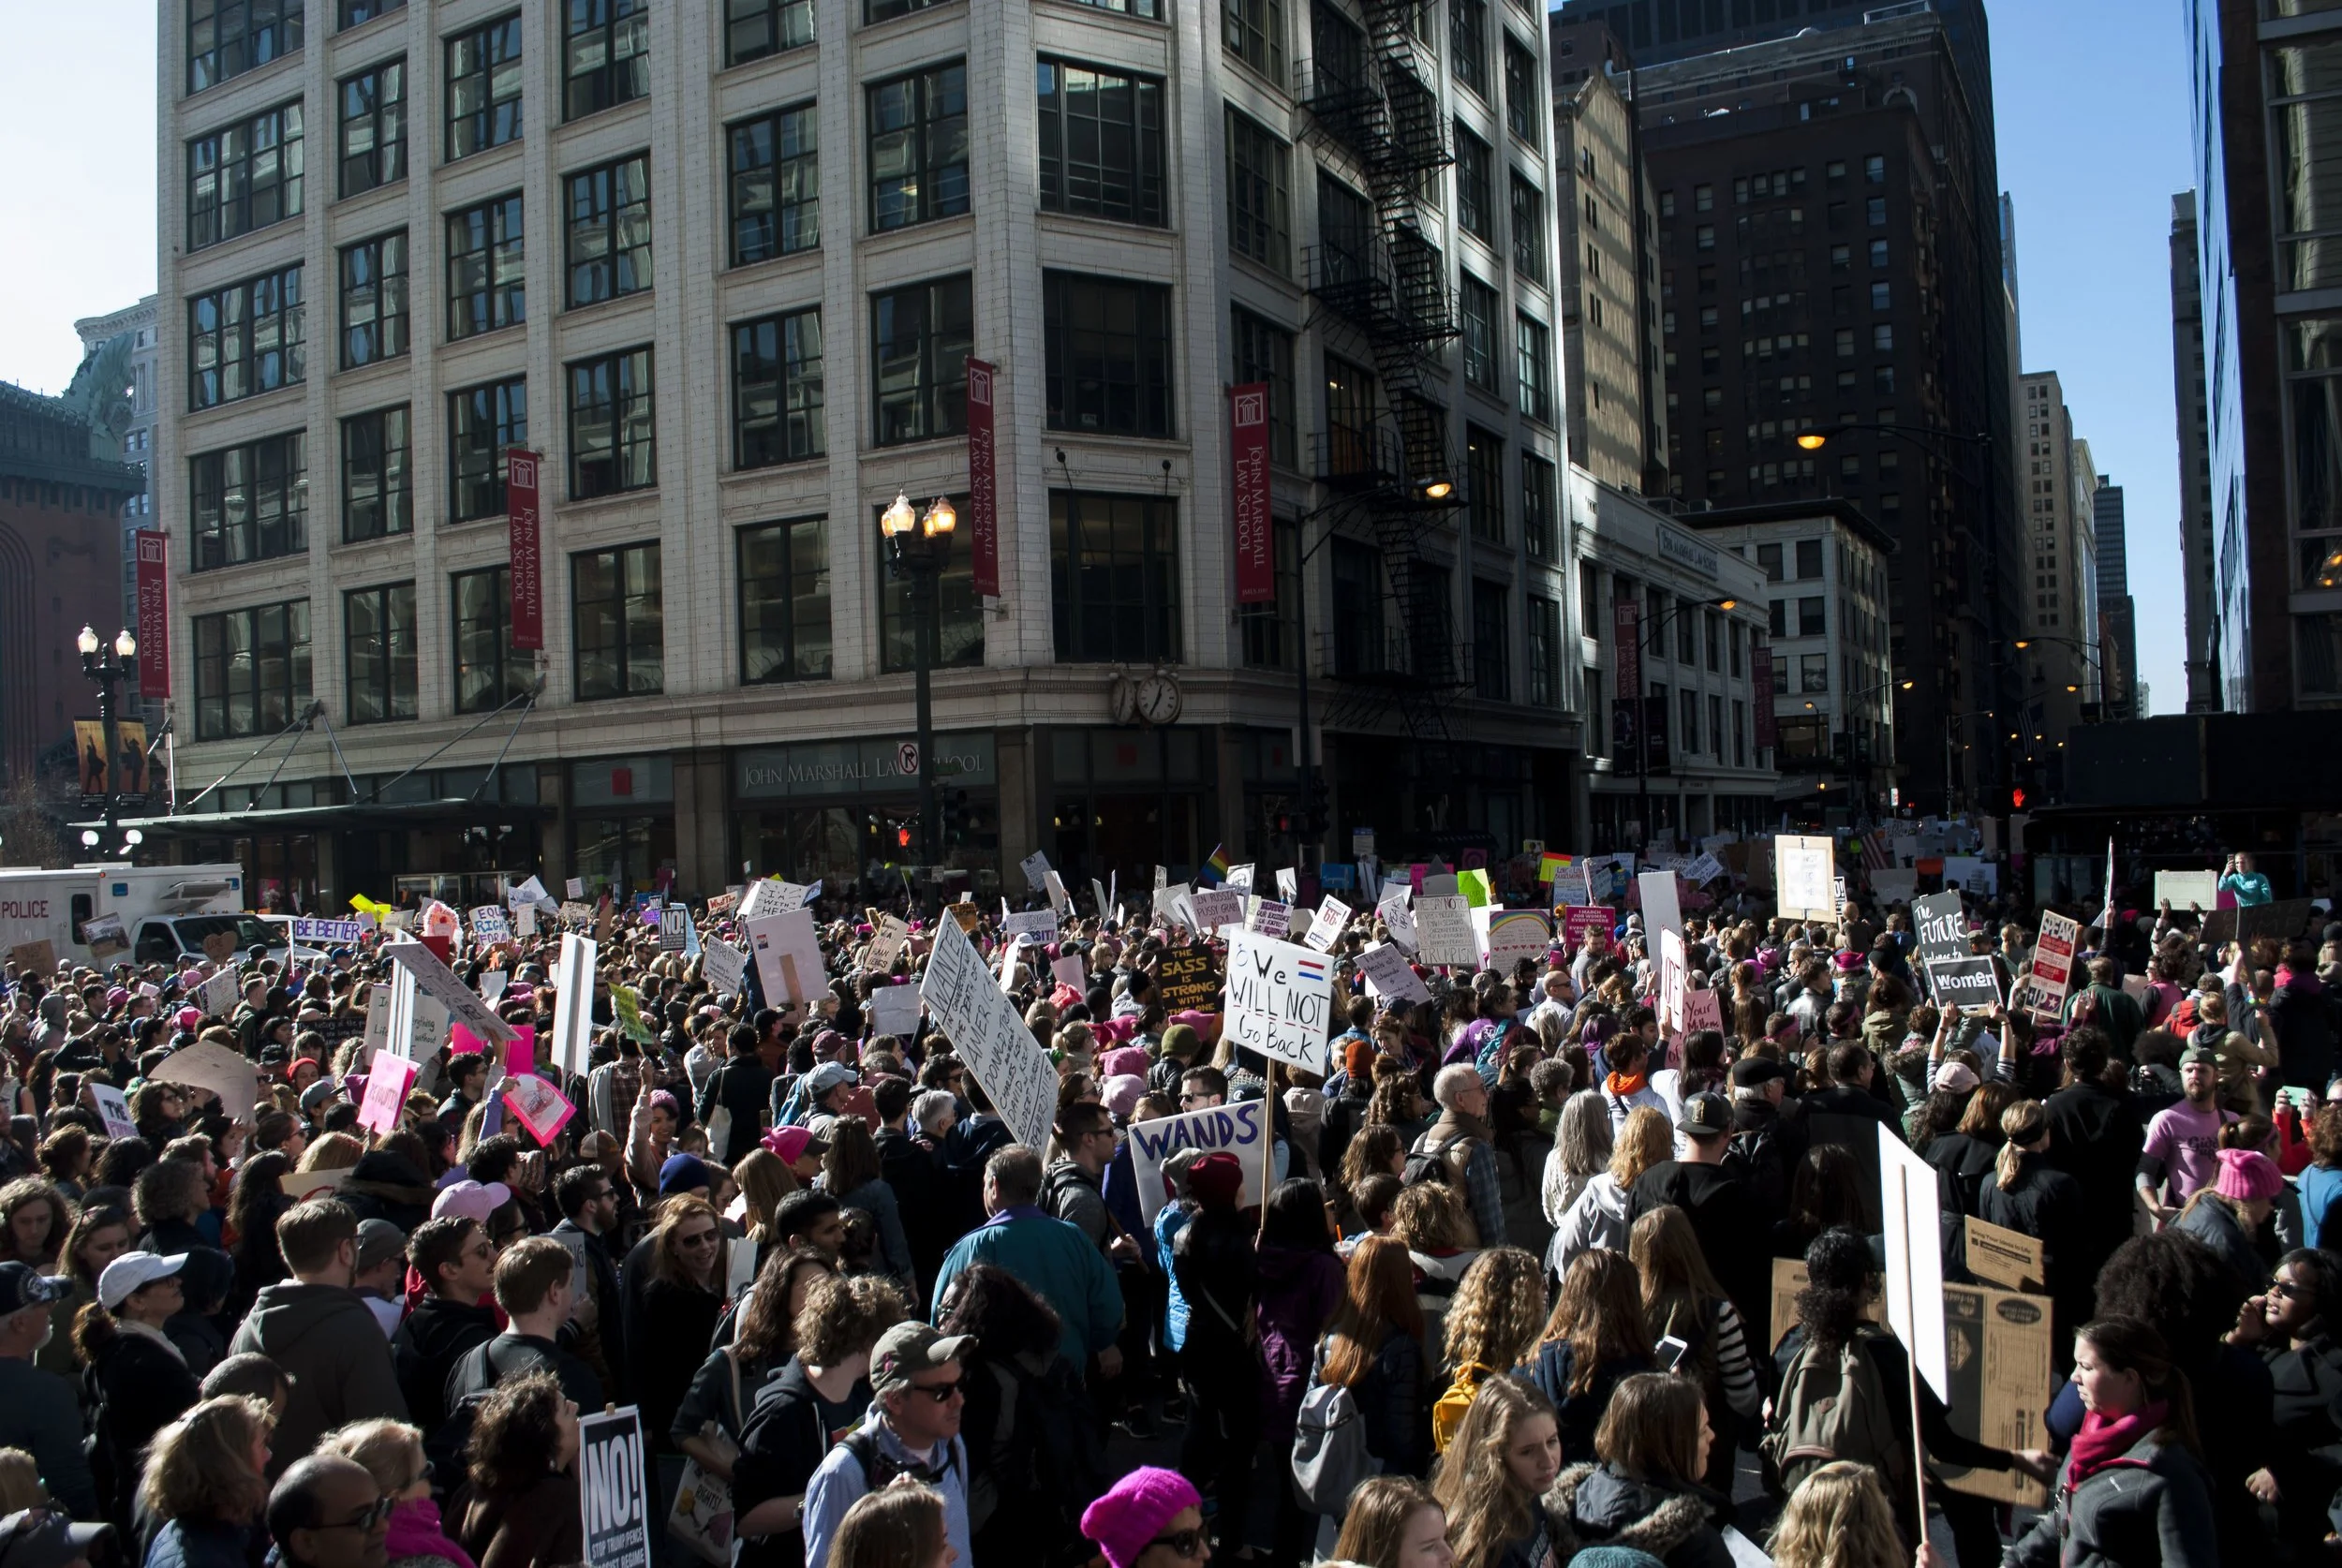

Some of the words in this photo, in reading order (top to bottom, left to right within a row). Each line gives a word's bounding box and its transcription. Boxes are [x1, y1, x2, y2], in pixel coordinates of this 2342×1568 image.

[972, 436, 981, 471] LAW
[981, 426, 991, 467] JOHN
[1237, 459, 1249, 491] LAW
[1249, 446, 1263, 483] JOHN
[972, 474, 983, 538] SCHOOL
[983, 473, 993, 558] MARSHALL
[512, 516, 522, 545] LAW
[523, 508, 535, 542] JOHN
[1238, 495, 1251, 555] SCHOOL
[1252, 489, 1266, 569] MARSHALL
[513, 548, 524, 601] SCHOOL
[525, 546, 536, 618] MARSHALL
[141, 586, 150, 612] LAW
[151, 579, 161, 607] JOHN
[141, 614, 151, 658] SCHOOL
[153, 612, 163, 672] MARSHALL
[746, 765, 782, 789] JOHN
[788, 759, 870, 782] MARSHALL
[2, 900, 49, 919] POLICE
[763, 899, 789, 908] WITH
[1196, 896, 1207, 905] IN
[1210, 891, 1236, 901] RUSSIA
[1197, 904, 1219, 916] PUSSY
[1221, 902, 1240, 913] GRABS
[1444, 896, 1456, 910] NO
[660, 910, 684, 935] NO!
[1387, 899, 1400, 930] SPEAK
[1914, 905, 1933, 921] The
[1920, 910, 1966, 945] FUTURE
[296, 919, 313, 936] BE
[316, 920, 361, 941] BETTER
[2042, 917, 2075, 944] SPEAK
[1162, 956, 1207, 977] SASS
[1172, 948, 1193, 957] THE
[1253, 949, 1286, 984] We
[1420, 946, 1475, 965] TRUMPISM
[971, 961, 978, 982] OF
[1181, 974, 1192, 984] IS
[959, 983, 976, 1024] DEATH
[1162, 981, 1216, 998] STRONG
[1177, 995, 1204, 1004] WITH
[1229, 973, 1279, 1017] WILL
[1286, 987, 1328, 1027] NOT
[946, 1013, 954, 1030] IN
[1195, 1003, 1215, 1013] ONE
[1685, 999, 1713, 1021] Your
[954, 1021, 967, 1044] THE
[966, 976, 997, 1072] AMERICA
[1238, 1014, 1261, 1043] Go
[1267, 1021, 1313, 1063] Back
[985, 1034, 1009, 1096] DONALD
[1000, 1063, 1017, 1110] CHARLES
[1014, 1035, 1023, 1060] KOCH
[1008, 1080, 1024, 1124] DAVID
[1019, 1042, 1029, 1074] KOCH
[102, 1099, 127, 1121] THE
[1132, 1103, 1260, 1161] WANDS
[1970, 1229, 1985, 1239] Bring
[1986, 1235, 1998, 1243] Your
[1999, 1238, 2014, 1249] Ideas
[588, 1433, 641, 1535] NO!
[695, 1483, 722, 1510] RIGHTS!
[591, 1542, 606, 1559] STOP
